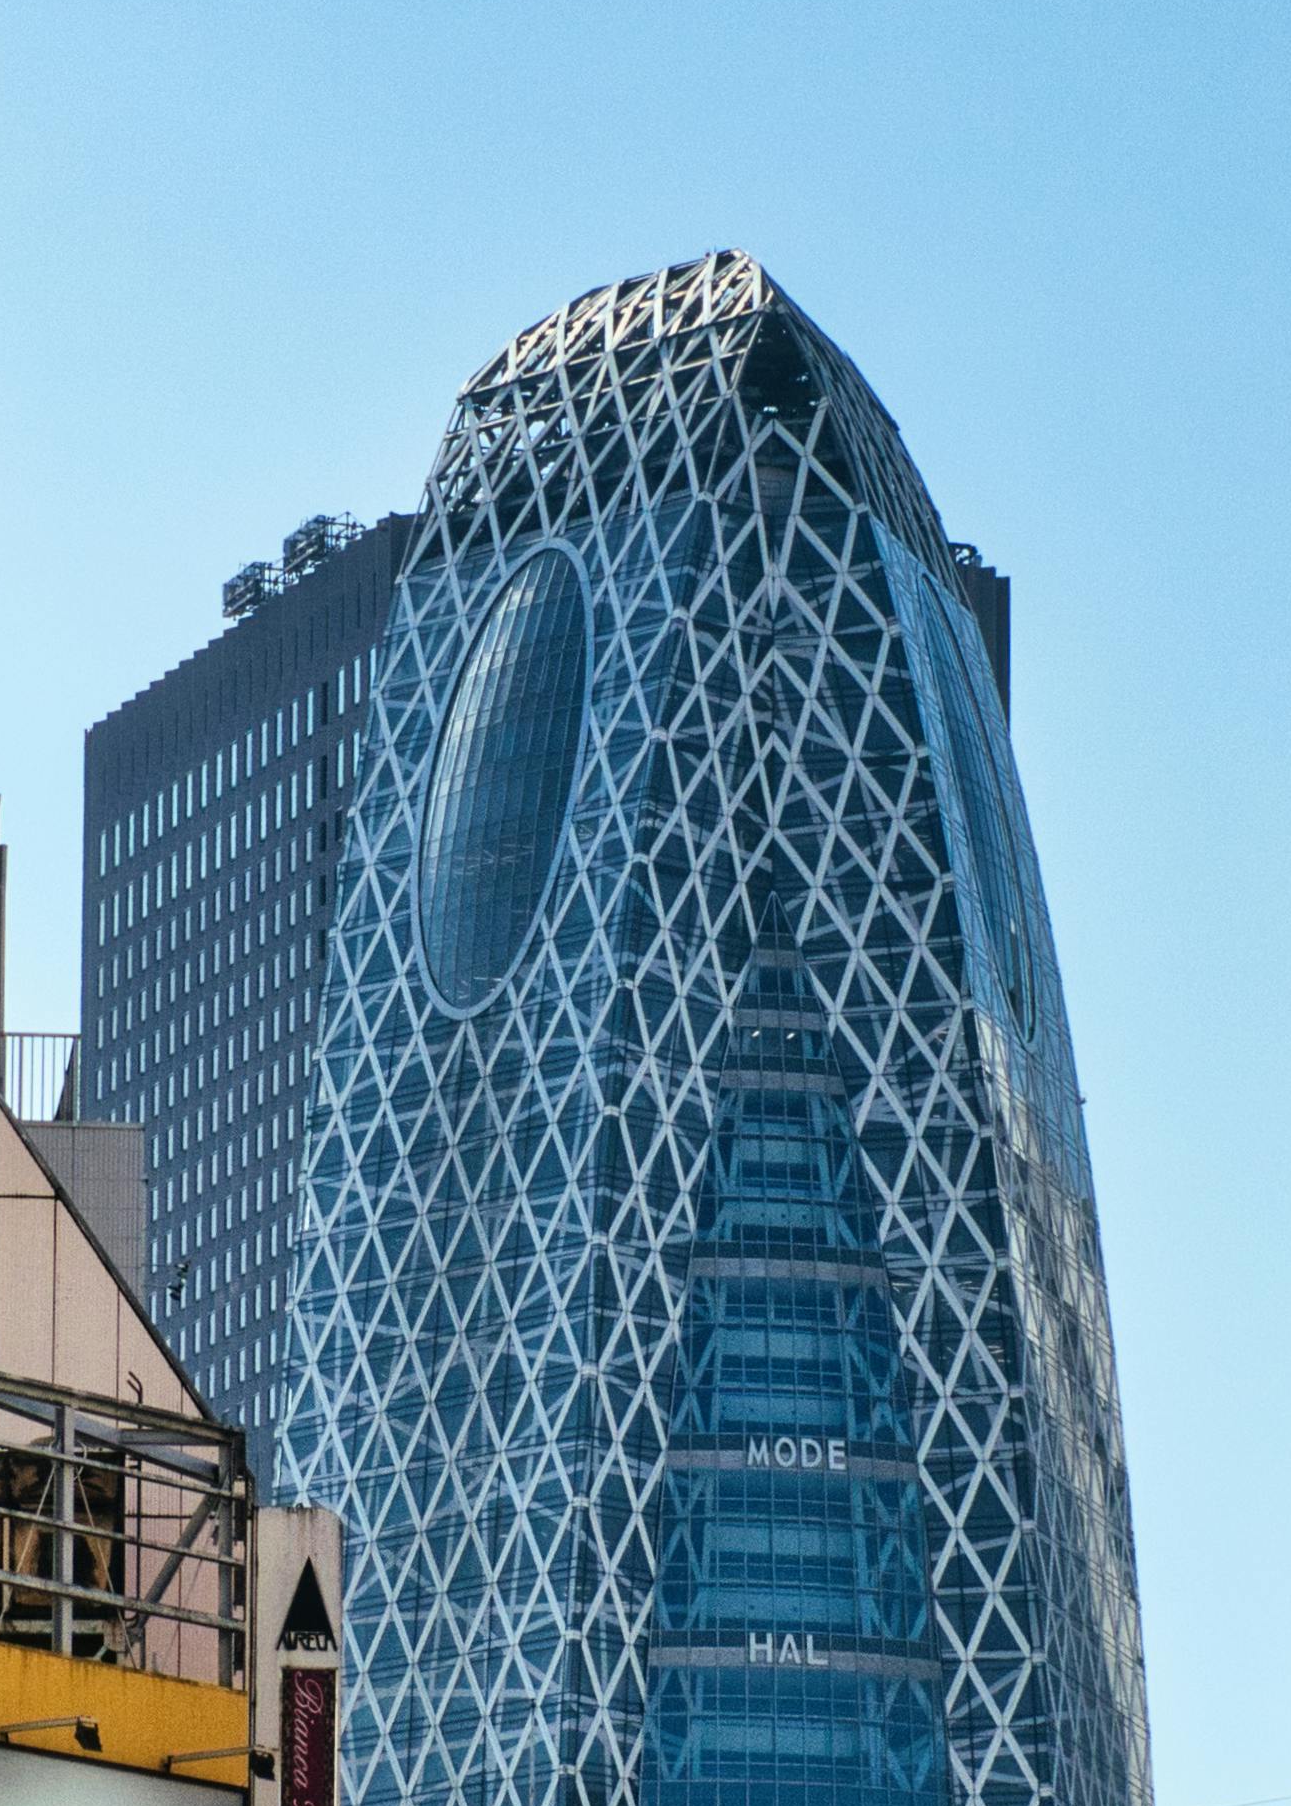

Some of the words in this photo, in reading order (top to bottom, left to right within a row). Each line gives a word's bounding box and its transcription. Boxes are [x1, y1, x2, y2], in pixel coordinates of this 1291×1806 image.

[746, 1435, 848, 1472] MODE
[748, 1632, 829, 1665] HAL
[293, 1670, 324, 1789] Bianca
